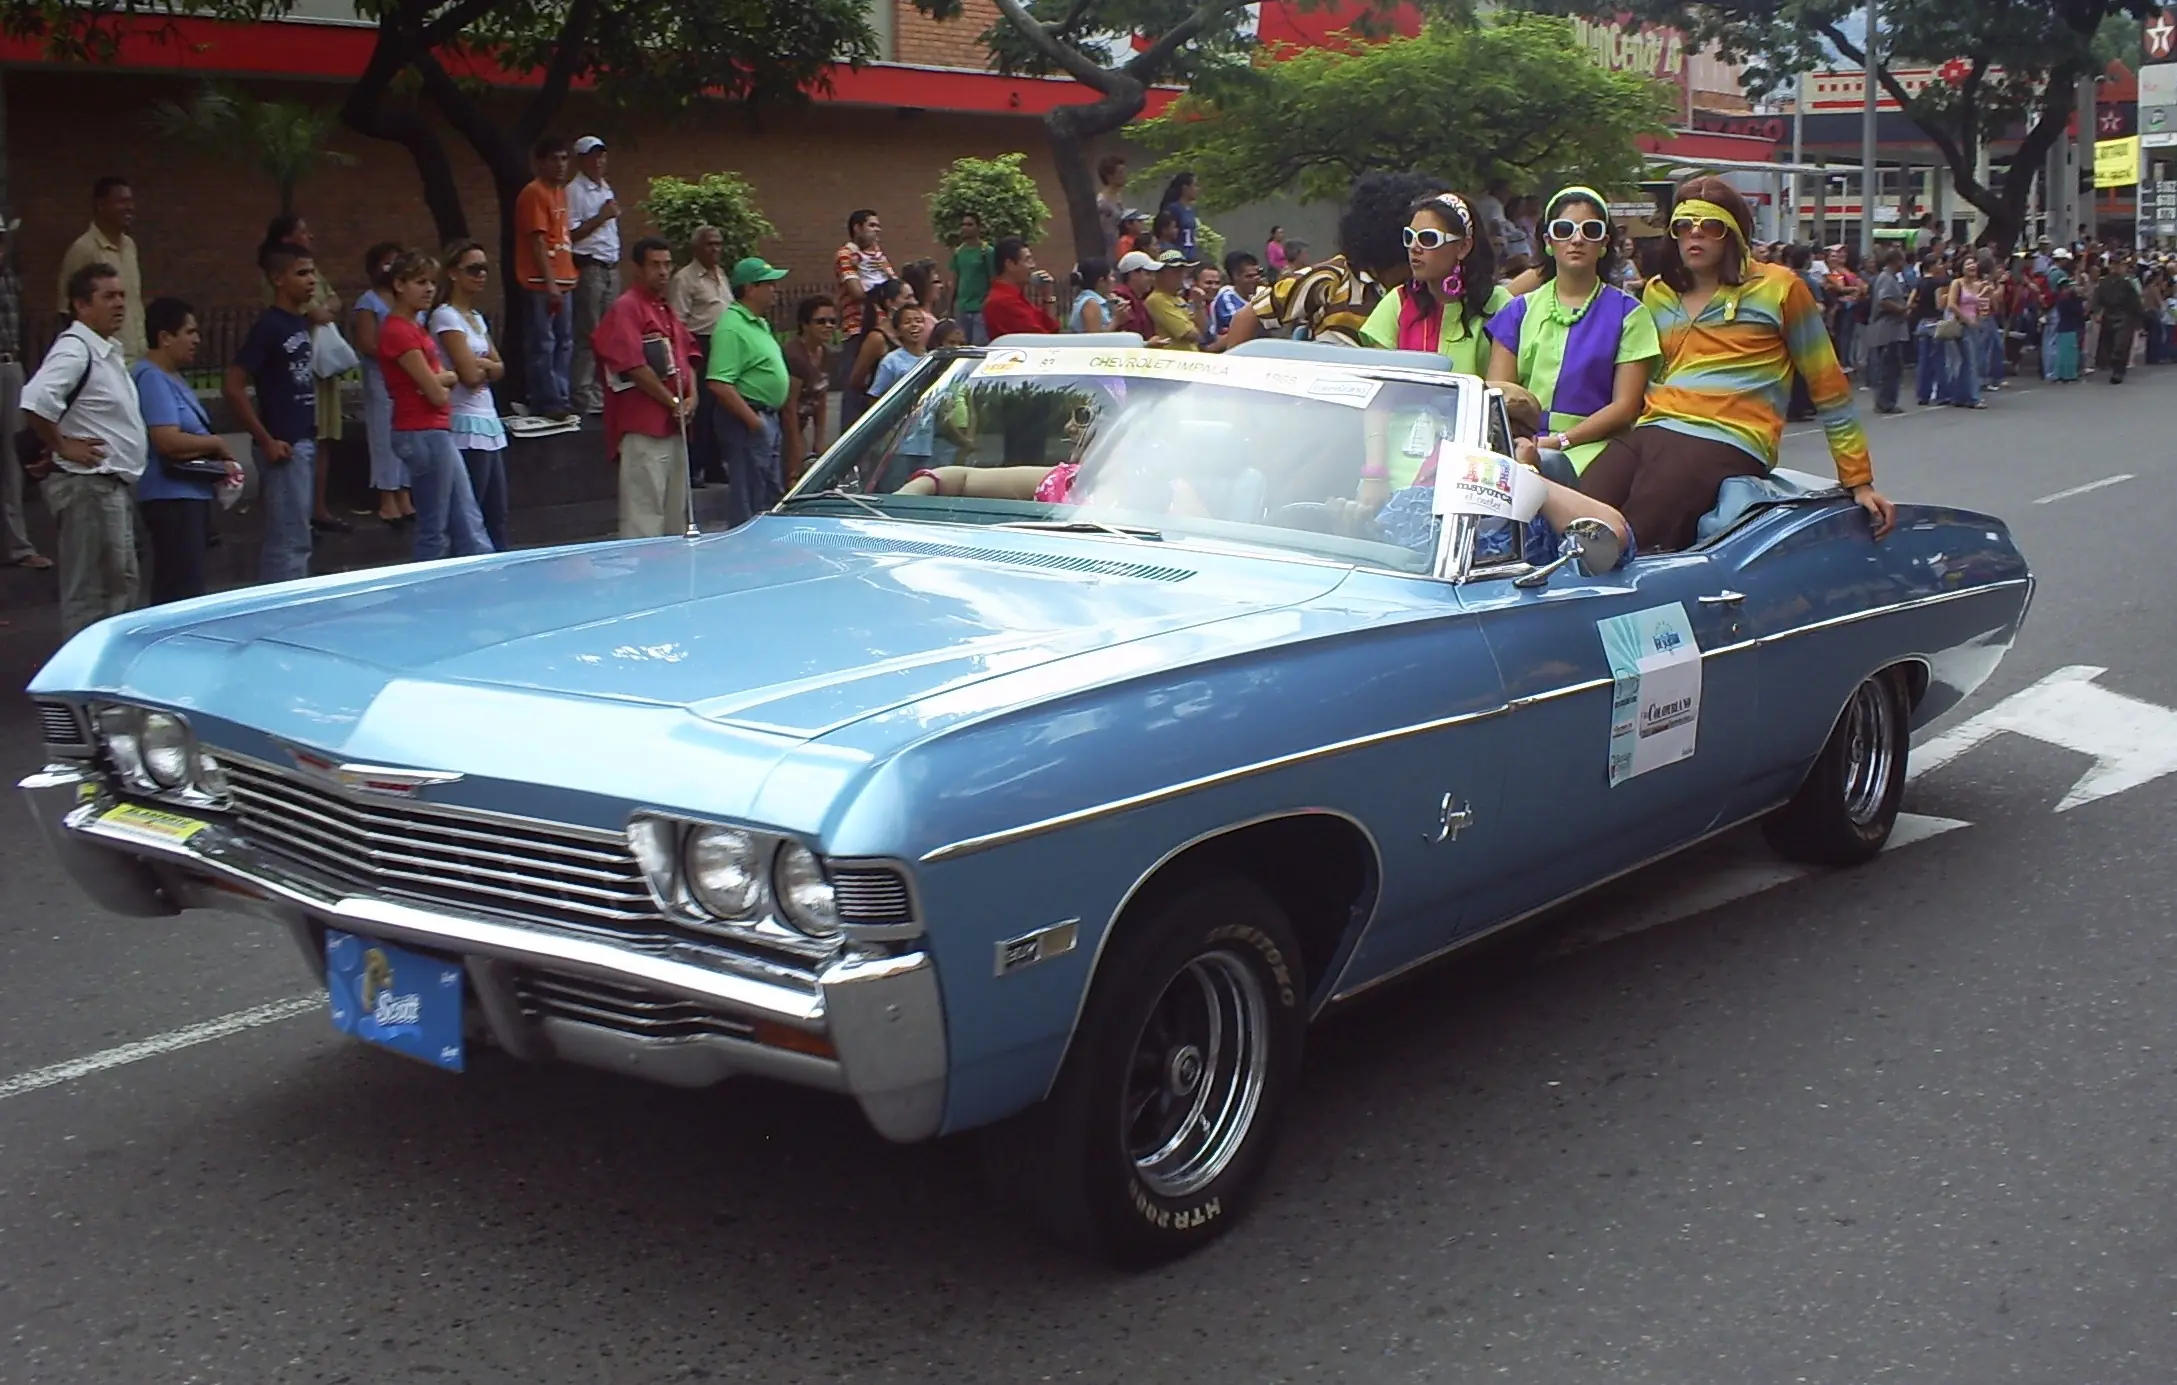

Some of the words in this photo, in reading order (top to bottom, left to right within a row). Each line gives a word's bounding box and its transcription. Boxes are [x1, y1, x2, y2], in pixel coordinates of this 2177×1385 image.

[1089, 356, 1172, 370] CHEVROLET
[1177, 359, 1230, 377] IMPALA
[1456, 482, 1513, 507] mayorca
[1173, 1196, 1222, 1231] HTR
